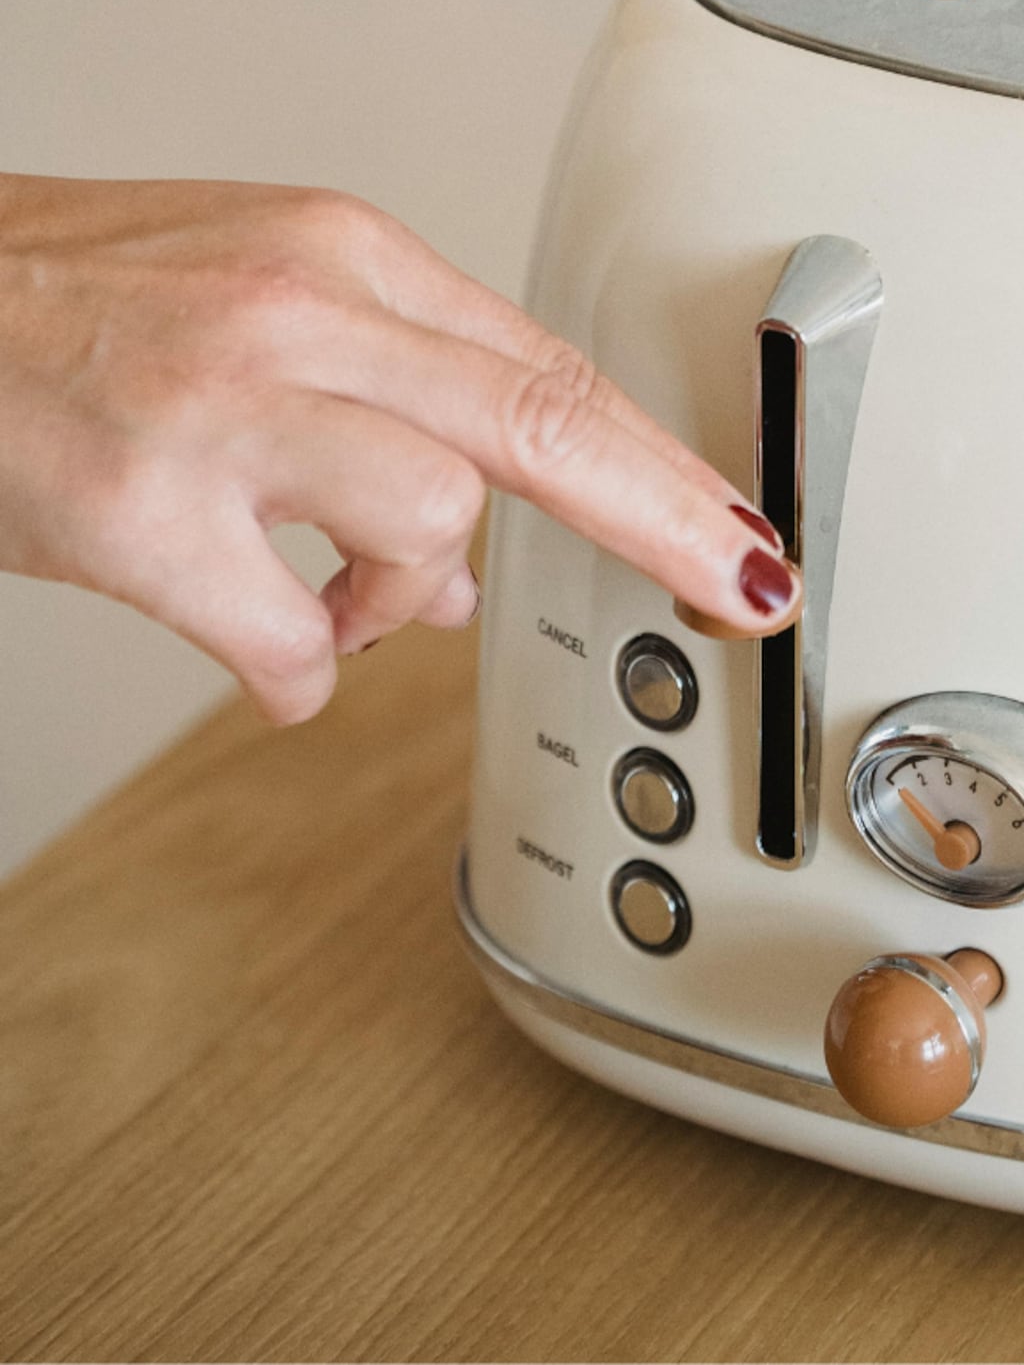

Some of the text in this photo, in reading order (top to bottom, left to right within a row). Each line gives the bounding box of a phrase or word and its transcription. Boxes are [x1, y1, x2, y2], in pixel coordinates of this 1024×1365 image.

[538, 617, 588, 659] CANCEL
[537, 732, 579, 768] BAGEL
[917, 772, 928, 787] 2
[944, 771, 953, 786] 3
[968, 781, 977, 794] 4
[994, 792, 1008, 808] 5
[517, 836, 575, 882] DEFROST
